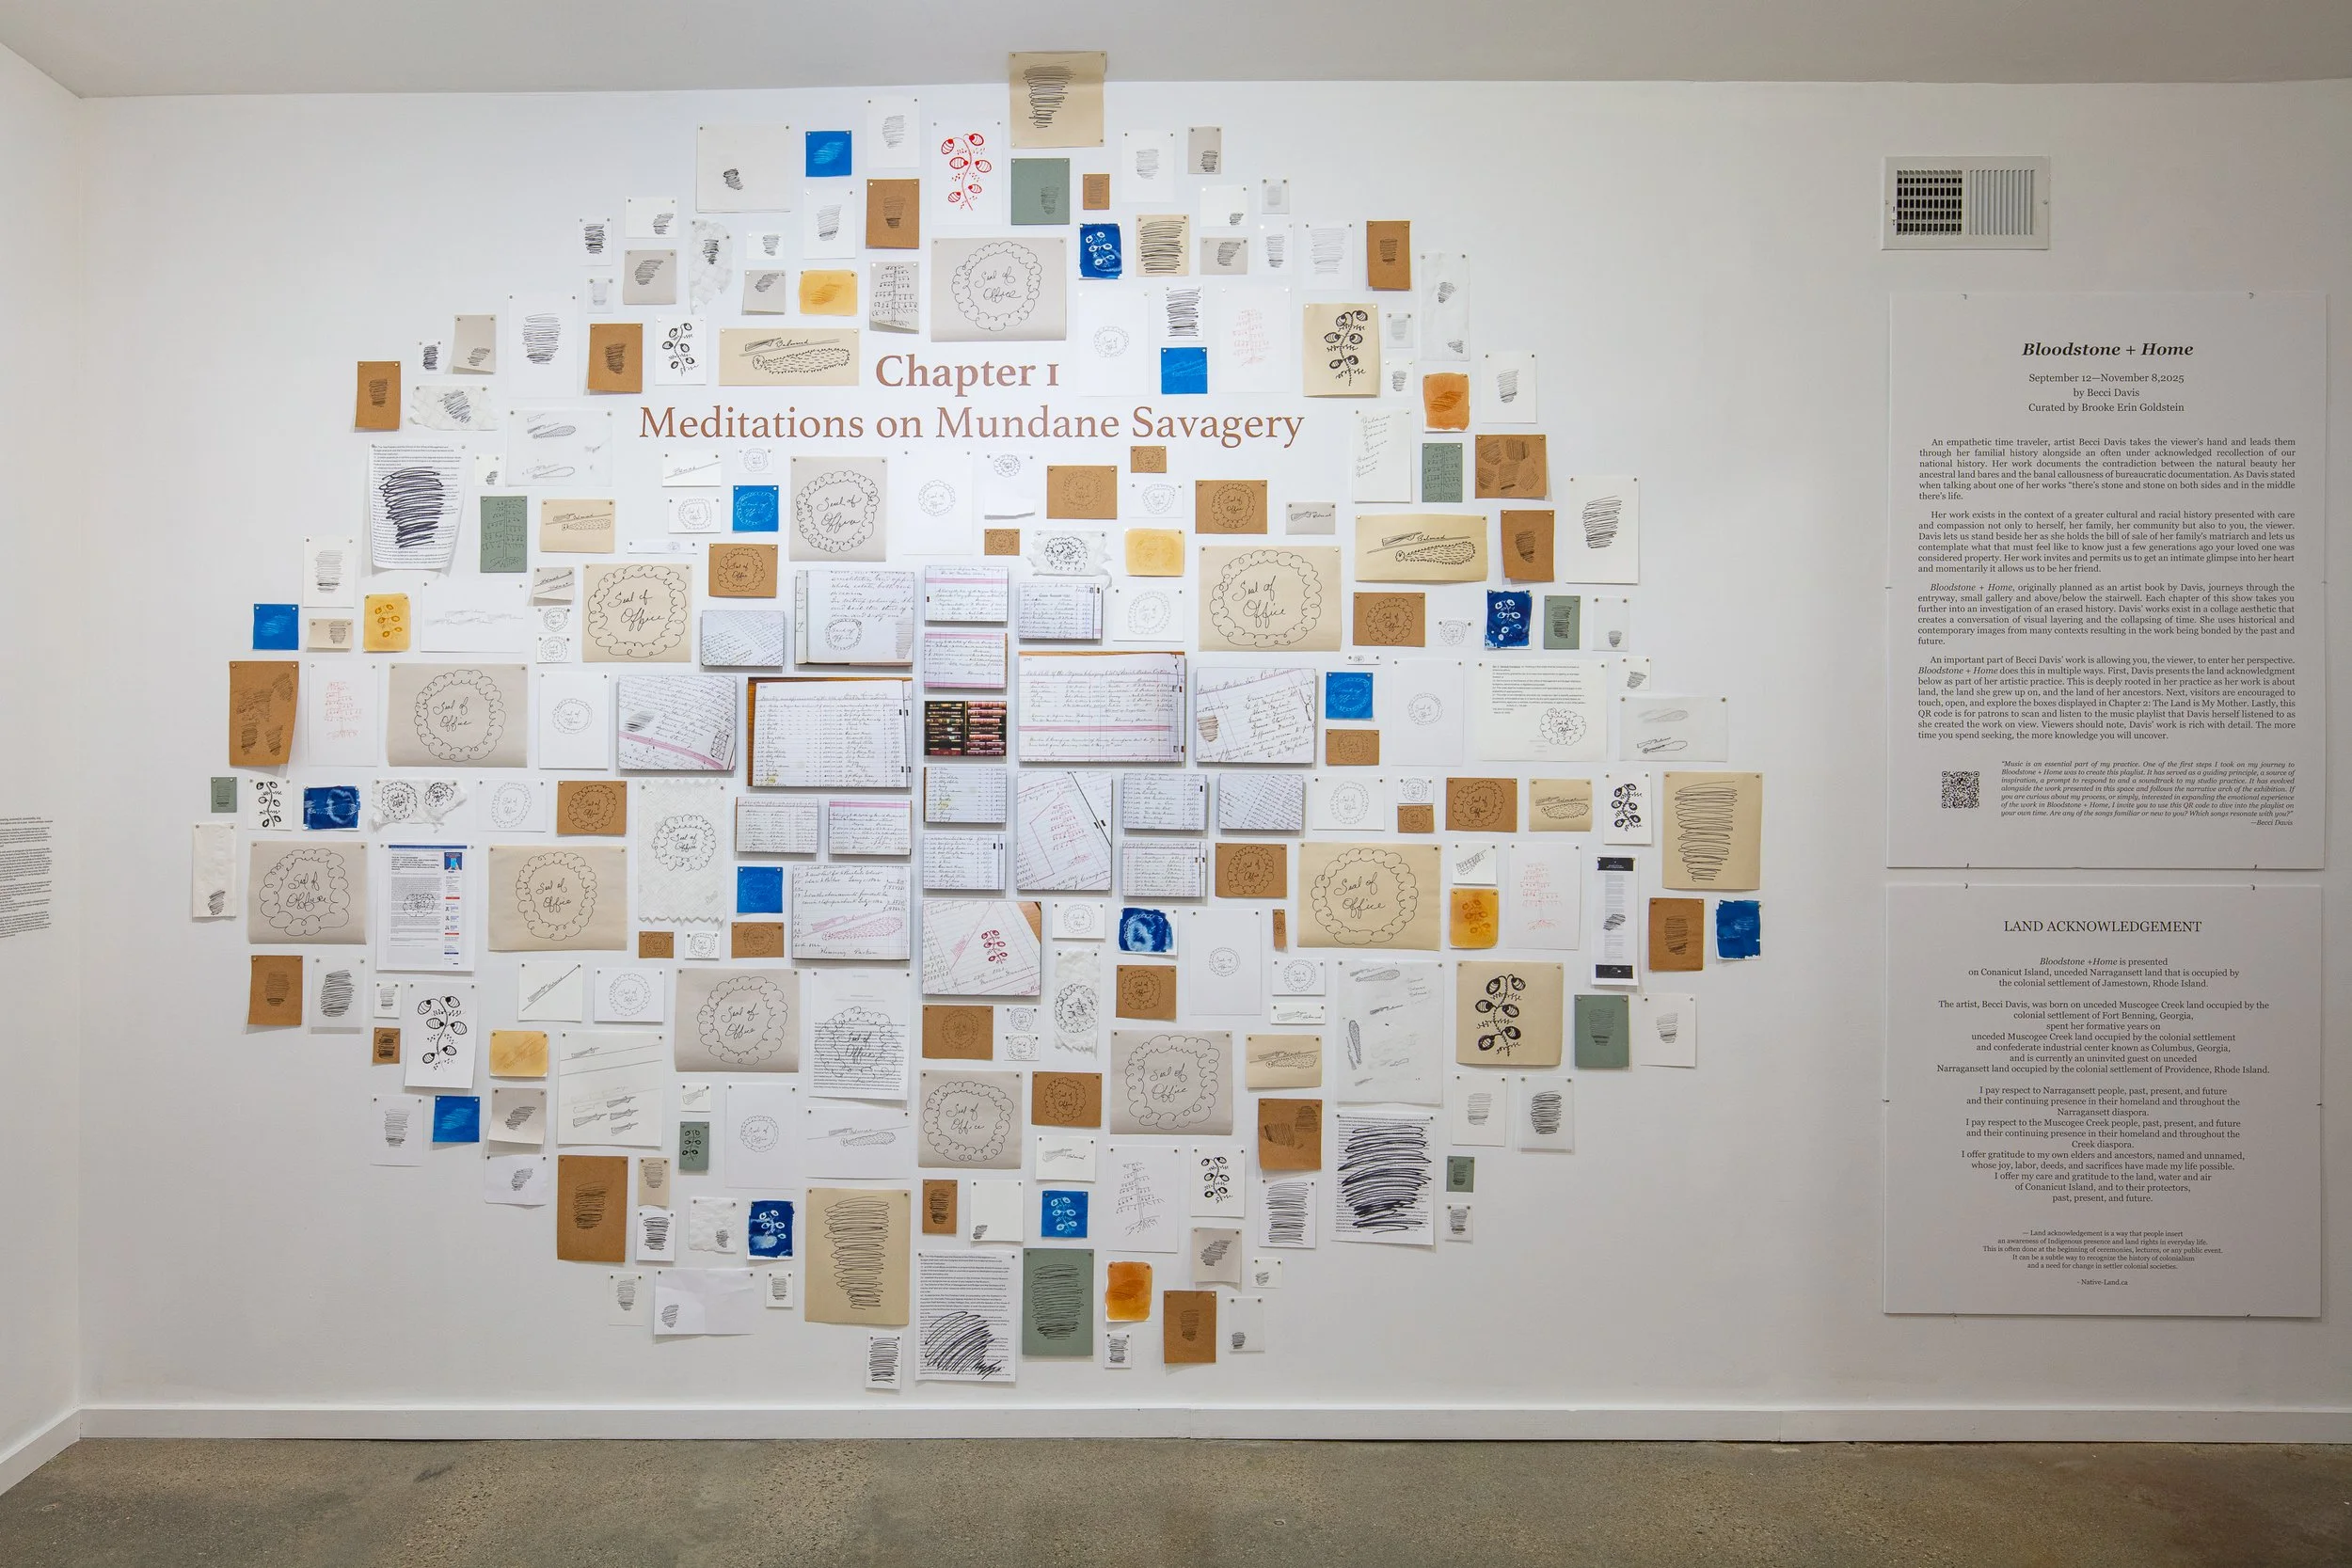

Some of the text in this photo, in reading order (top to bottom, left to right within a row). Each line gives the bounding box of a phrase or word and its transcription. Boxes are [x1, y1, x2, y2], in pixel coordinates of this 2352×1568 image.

[2021, 342, 2194, 356] Bloodstone + Home
[877, 355, 1059, 397] Chapter 1
[2028, 372, 2185, 385] September 12—November 8,2025
[2073, 388, 2141, 399] by Becci Davis
[2028, 402, 2185, 415] Curated by Brooke Erin Goldstein
[639, 405, 1305, 450] Meditations on Mundane Savagery
[1931, 437, 1944, 447] An
[1946, 437, 1993, 449] empathetic
[1994, 437, 2014, 447] time
[2016, 437, 2051, 448] traveler,
[2054, 437, 2075, 447] artist
[2078, 437, 2101, 447] Becci
[2104, 437, 2127, 447] Davis
[2129, 437, 2152, 447] takes
[2153, 437, 2168, 447] the
[2206, 437, 2228, 447] hand
[2231, 437, 2247, 447] and
[2249, 437, 2271, 447] leads
[2274, 437, 2296, 447] them
[1947, 492, 1963, 500] life.
[1930, 583, 1977, 592] Bloodstone
[1987, 583, 2015, 593] Home,
[2017, 583, 2058, 594] originally
[2058, 583, 2093, 594] planned
[2120, 583, 2142, 592] artist
[2144, 583, 2166, 592] book
[2168, 583, 2179, 594] by
[2180, 583, 2206, 593] Davis,
[2207, 585, 2244, 594] journeys
[2246, 583, 2280, 594] through
[2281, 583, 2296, 592] the
[1918, 731, 1937, 739] time
[1938, 733, 1954, 741] you
[1954, 731, 1980, 741] spend
[1980, 731, 2015, 741] seeking,
[2016, 731, 2030, 739] the
[2055, 731, 2099, 741] knowledge
[2099, 733, 2115, 741] you
[2117, 731, 2132, 739] will
[2004, 920, 2203, 932] LAND ACKNOWLEDGEMENT
[2040, 957, 2086, 966] Bloodstone
[2119, 958, 2127, 966] is
[2127, 957, 2169, 968] presented
[1998, 978, 2209, 989] the colonial settlement of Jamestown, Rhode Island.
[2045, 1022, 2070, 1032] spent
[2070, 1022, 2085, 1030] her
[2086, 1022, 2126, 1030] formative
[2126, 1023, 2149, 1032] years
[1976, 1043, 1992, 1052] and
[1993, 1043, 2042, 1052] confederate
[2042, 1043, 2083, 1052] industrial
[2111, 1043, 2139, 1052] known
[2151, 1043, 2195, 1053] Columbus,
[2196, 1043, 2231, 1053] Georgia,
[2057, 1108, 2150, 1118] Narragansett diaspora.
[2071, 1140, 2135, 1150] Creek diaspora.
[2052, 1193, 2153, 1205] past, present, and future.
